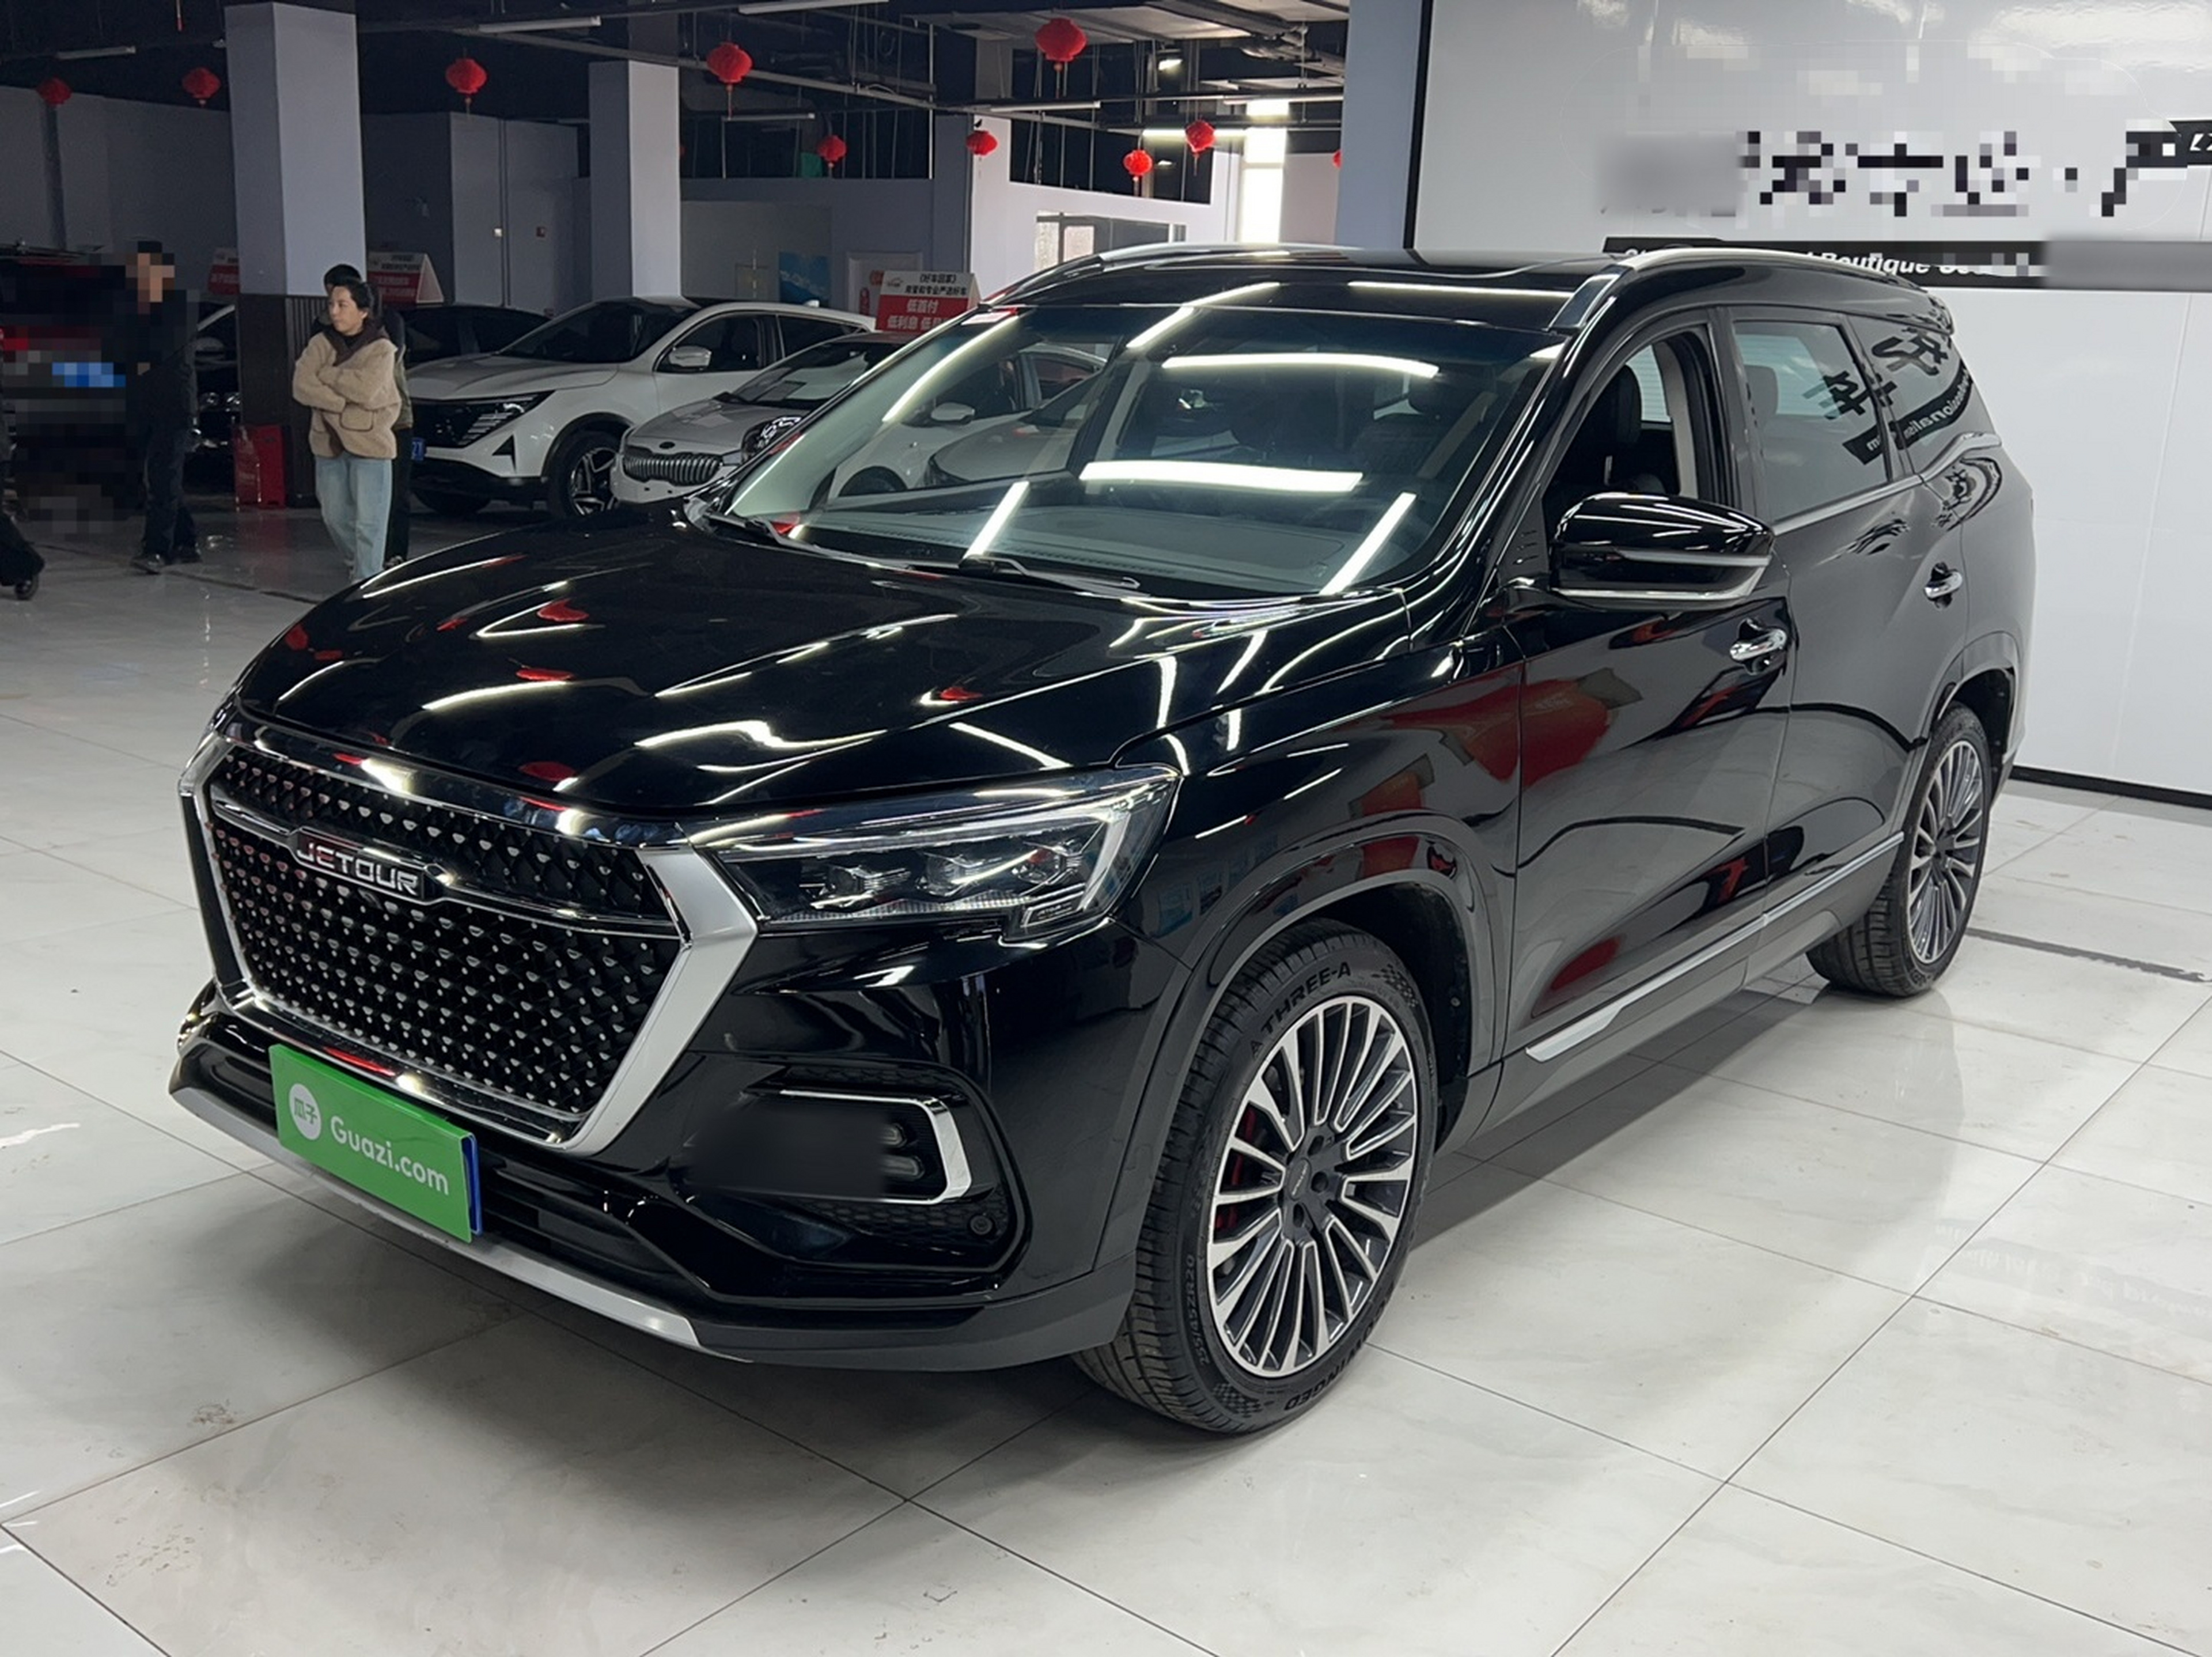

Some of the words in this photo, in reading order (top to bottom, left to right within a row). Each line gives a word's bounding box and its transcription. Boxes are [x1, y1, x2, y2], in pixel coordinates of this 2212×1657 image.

[296, 842, 418, 896] JETOUR
[1260, 961, 1351, 1034] THREE-A
[294, 1097, 319, 1125] 瓜子
[330, 1115, 449, 1196] Guazi.com
[1184, 1253, 1210, 1365] 255/45ZR20
